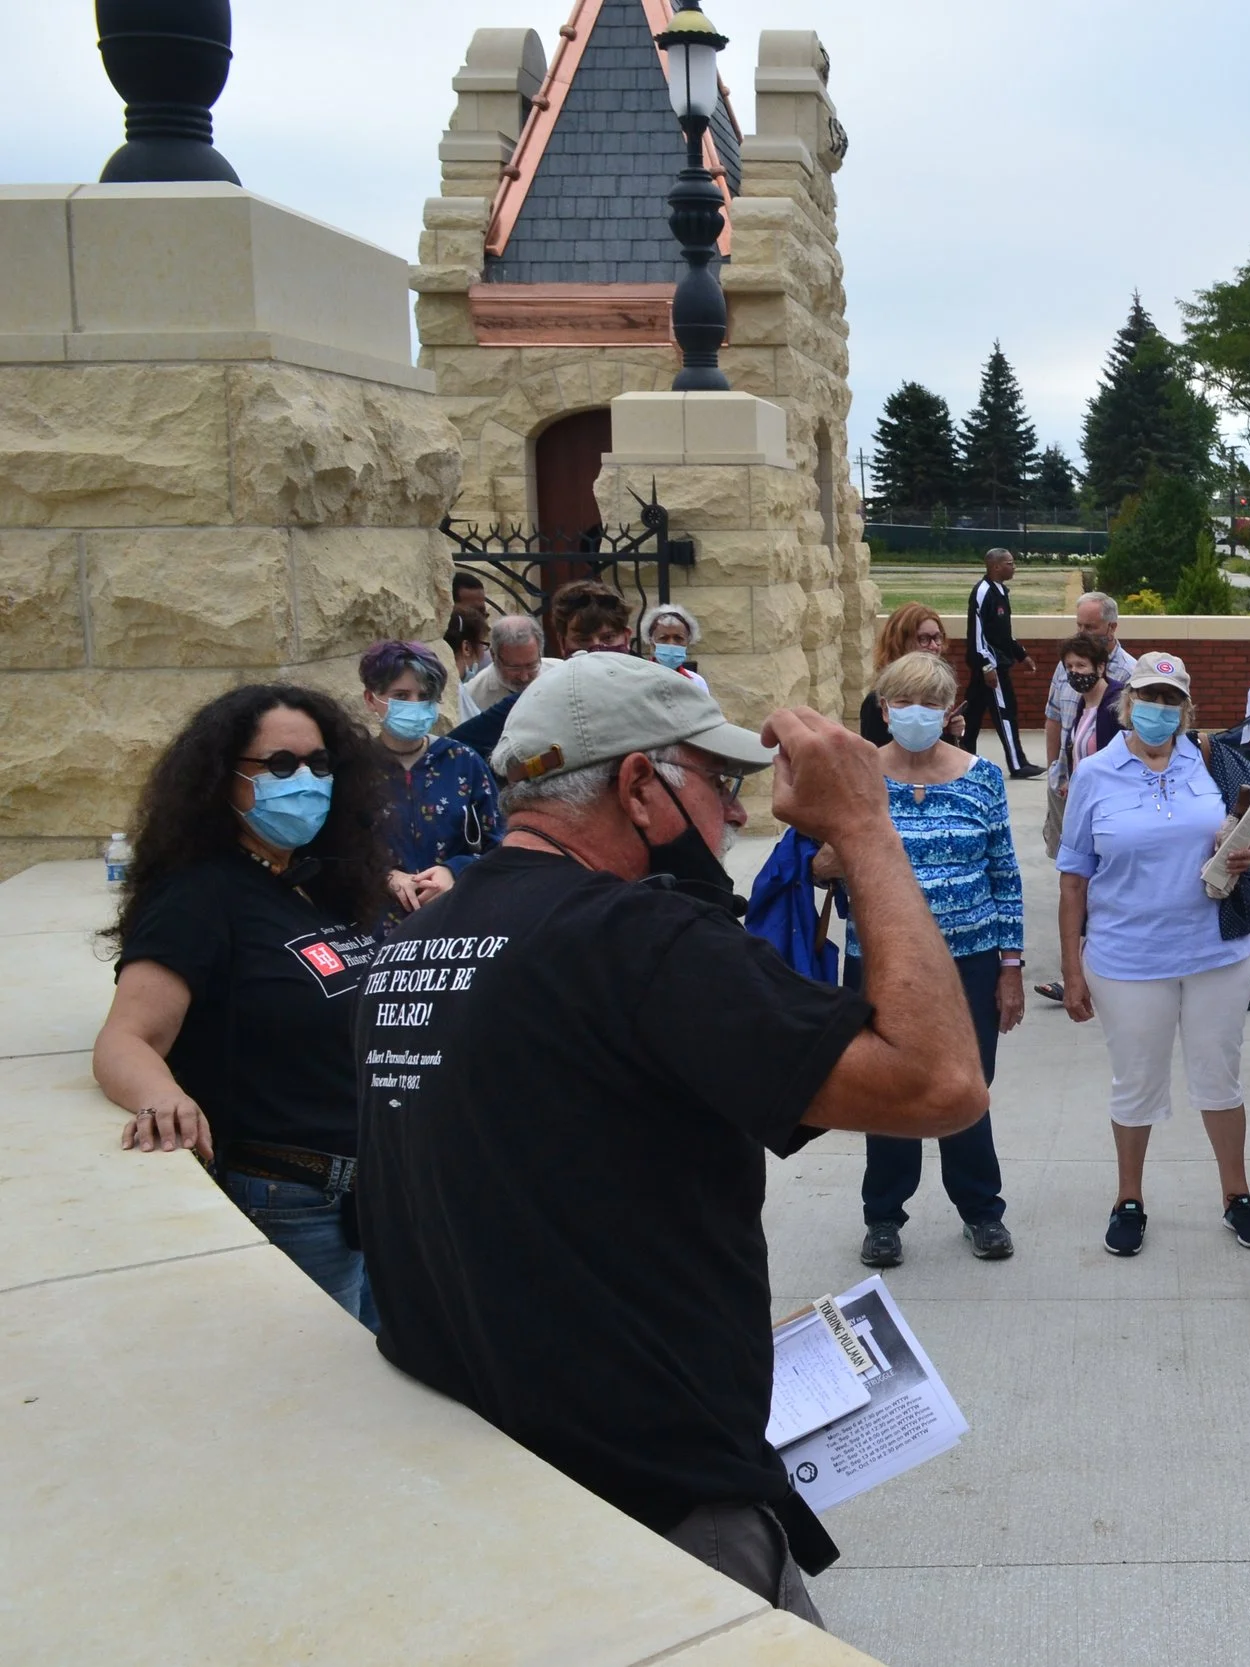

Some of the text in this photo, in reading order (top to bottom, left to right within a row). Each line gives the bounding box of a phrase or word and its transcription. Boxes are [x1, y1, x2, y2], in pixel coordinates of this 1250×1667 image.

[328, 939, 359, 952] Illinois
[389, 940, 421, 963] THE
[422, 937, 478, 960] VOICE
[477, 936, 509, 958] OF
[364, 967, 476, 995] THE PEOPLE BE
[375, 1003, 433, 1027] HEARD!
[420, 1050, 442, 1065] words
[820, 1300, 867, 1368] TOURING PULLMAN
[863, 1368, 896, 1391] STRUGGLE
[839, 1434, 850, 1443] Sep
[889, 1404, 906, 1415] WTTW
[906, 1396, 922, 1406] Prime
[842, 1425, 853, 1434] Sep
[892, 1395, 909, 1406] WTTW
[843, 1447, 855, 1455] Sep
[897, 1414, 914, 1426] WTTW
[915, 1406, 930, 1416] Prime
[850, 1436, 861, 1445] Sep
[903, 1404, 920, 1415] WTTW
[847, 1452, 858, 1461] Sep
[901, 1420, 918, 1431] WTTW
[918, 1411, 934, 1422] Prime
[850, 1458, 862, 1467] Sep
[904, 1425, 921, 1437] WTTW
[921, 1417, 937, 1427] Prime
[911, 1429, 929, 1441] WTTW
